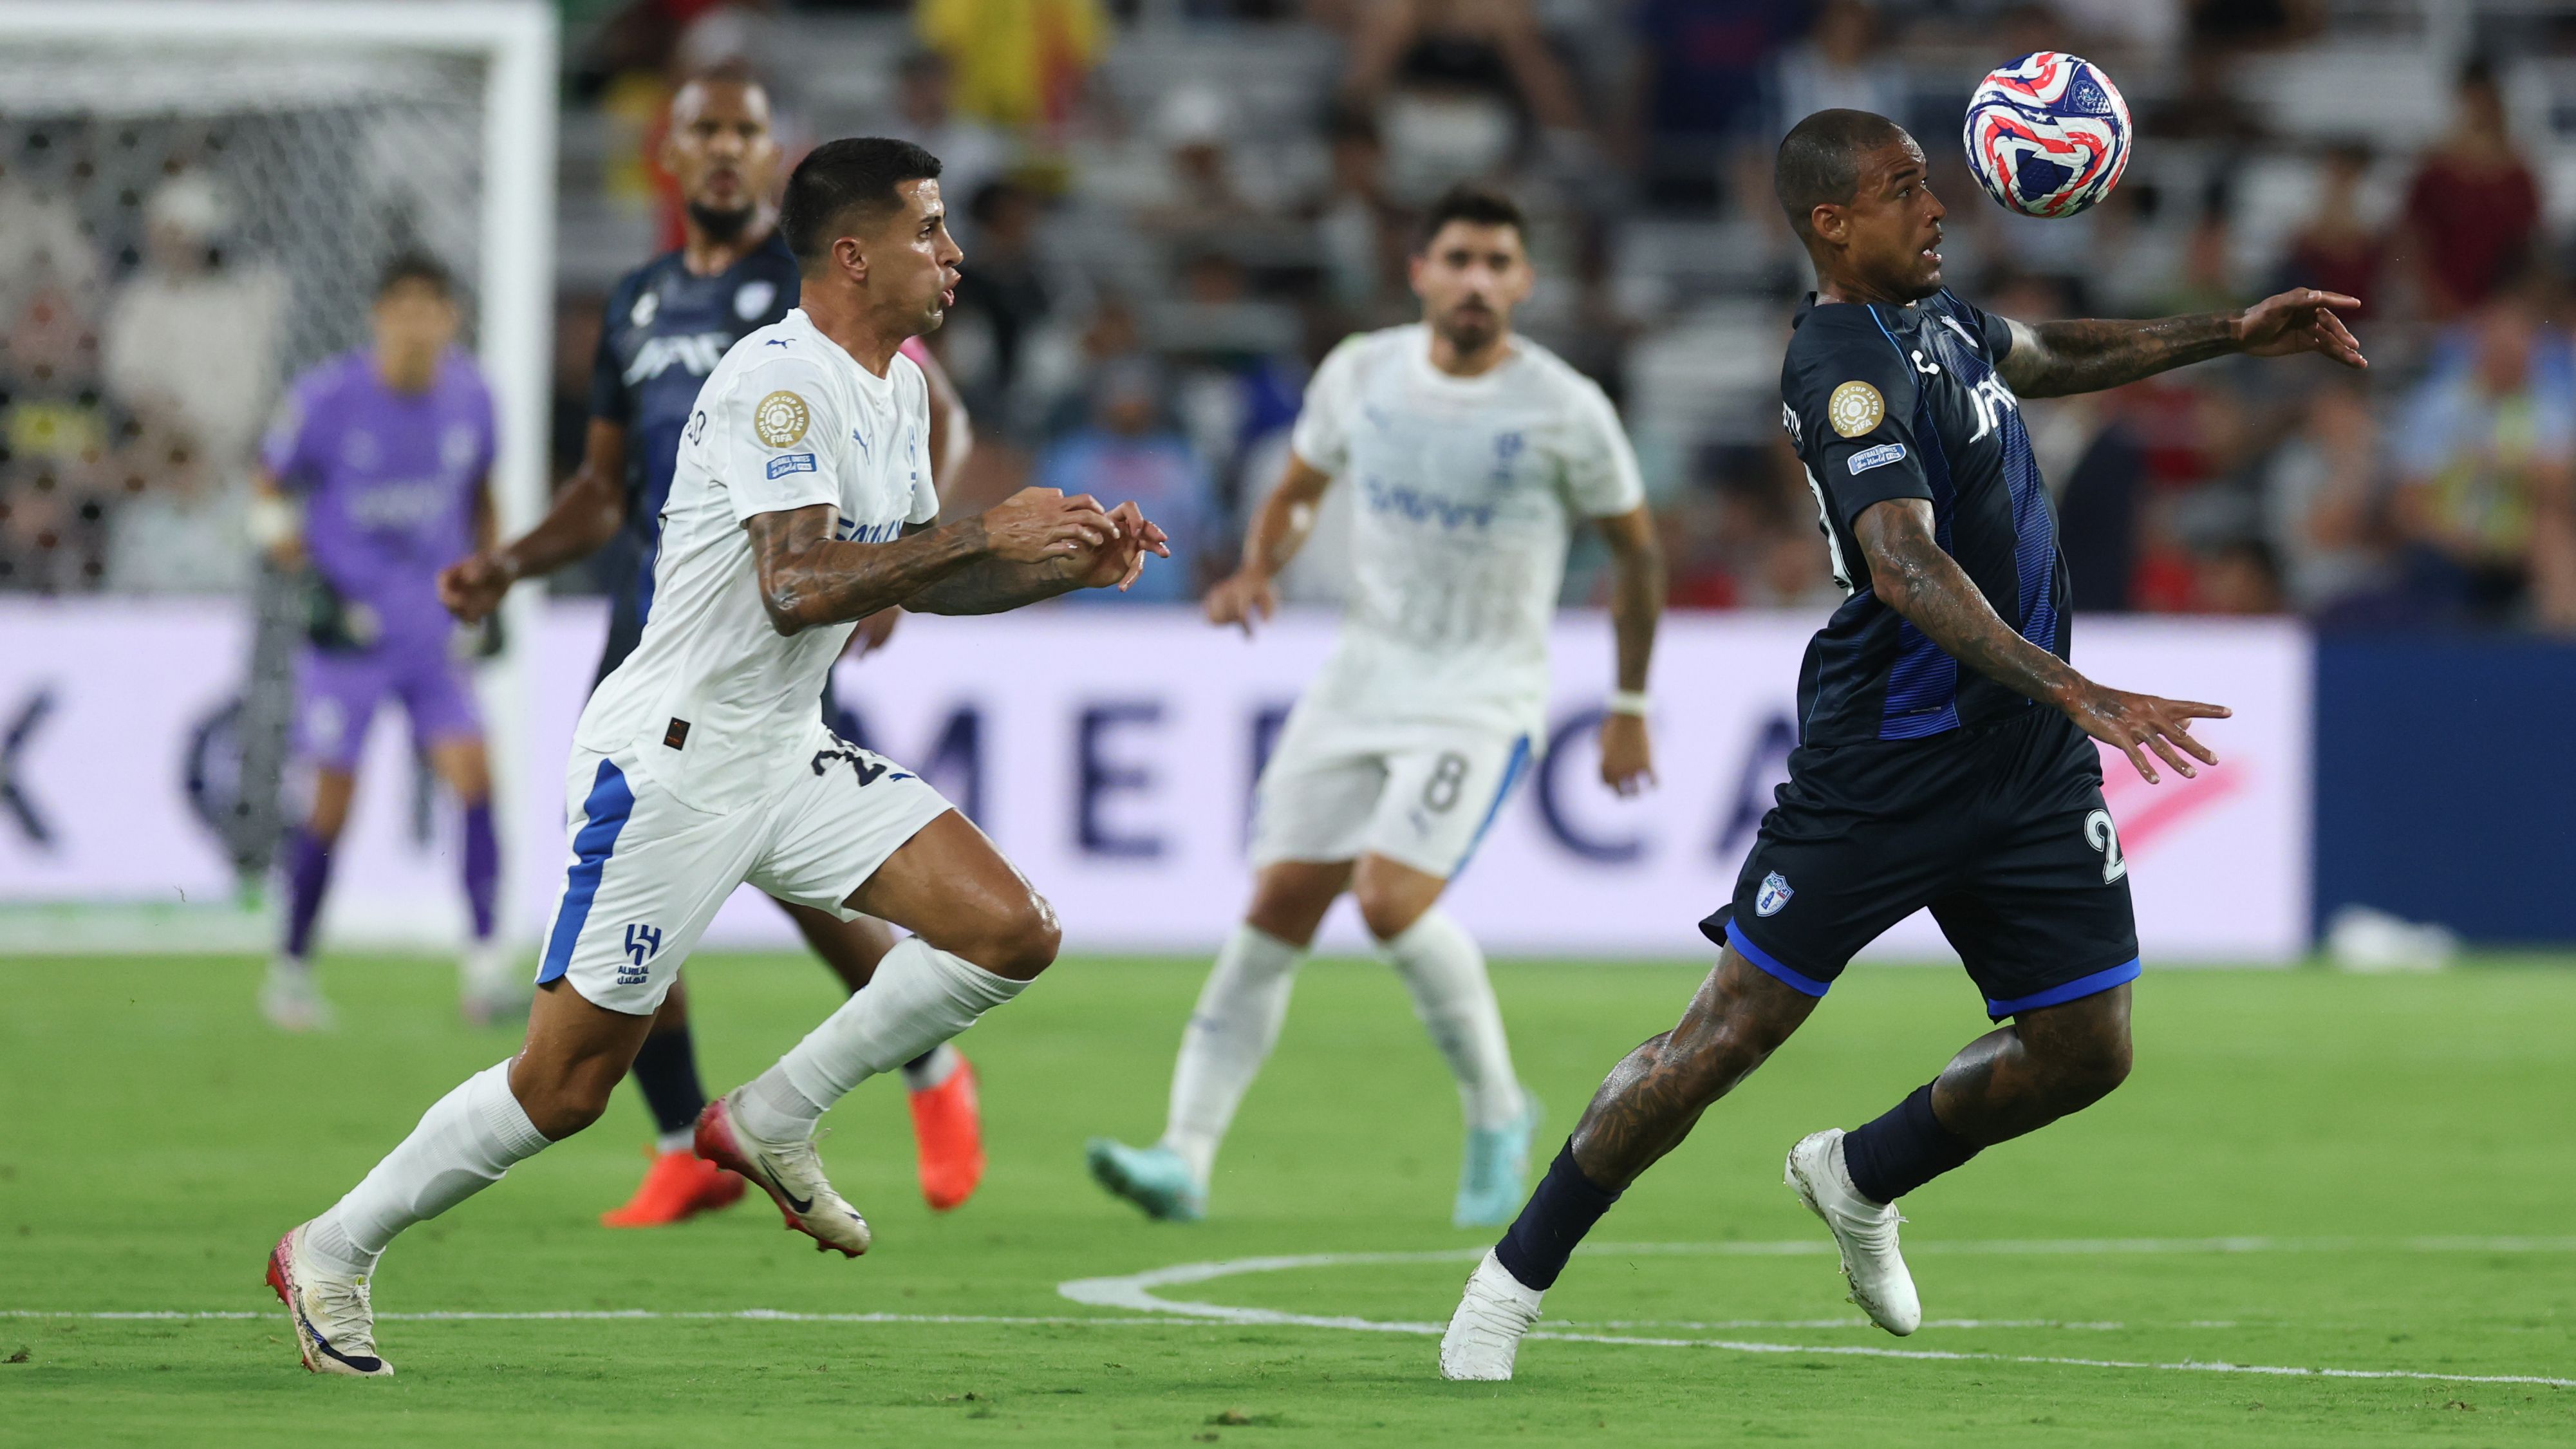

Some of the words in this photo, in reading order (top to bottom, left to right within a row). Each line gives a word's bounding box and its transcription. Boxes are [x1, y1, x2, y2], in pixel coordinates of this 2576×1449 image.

[781, 396, 797, 404] CUP
[1833, 389, 1849, 415] WORLD
[1866, 390, 1876, 400] 25
[758, 396, 780, 418] WORLD
[1871, 400, 1879, 415] USA
[758, 420, 770, 438] CLUB
[794, 416, 805, 431] USA
[1834, 416, 1848, 431] CLUB
[1851, 419, 1874, 434] FIFA
[770, 433, 794, 444] FIFA
[1854, 449, 1880, 462] FOOTBALL
[1421, 750, 1471, 814] 8
[2084, 809, 2127, 884] 2
